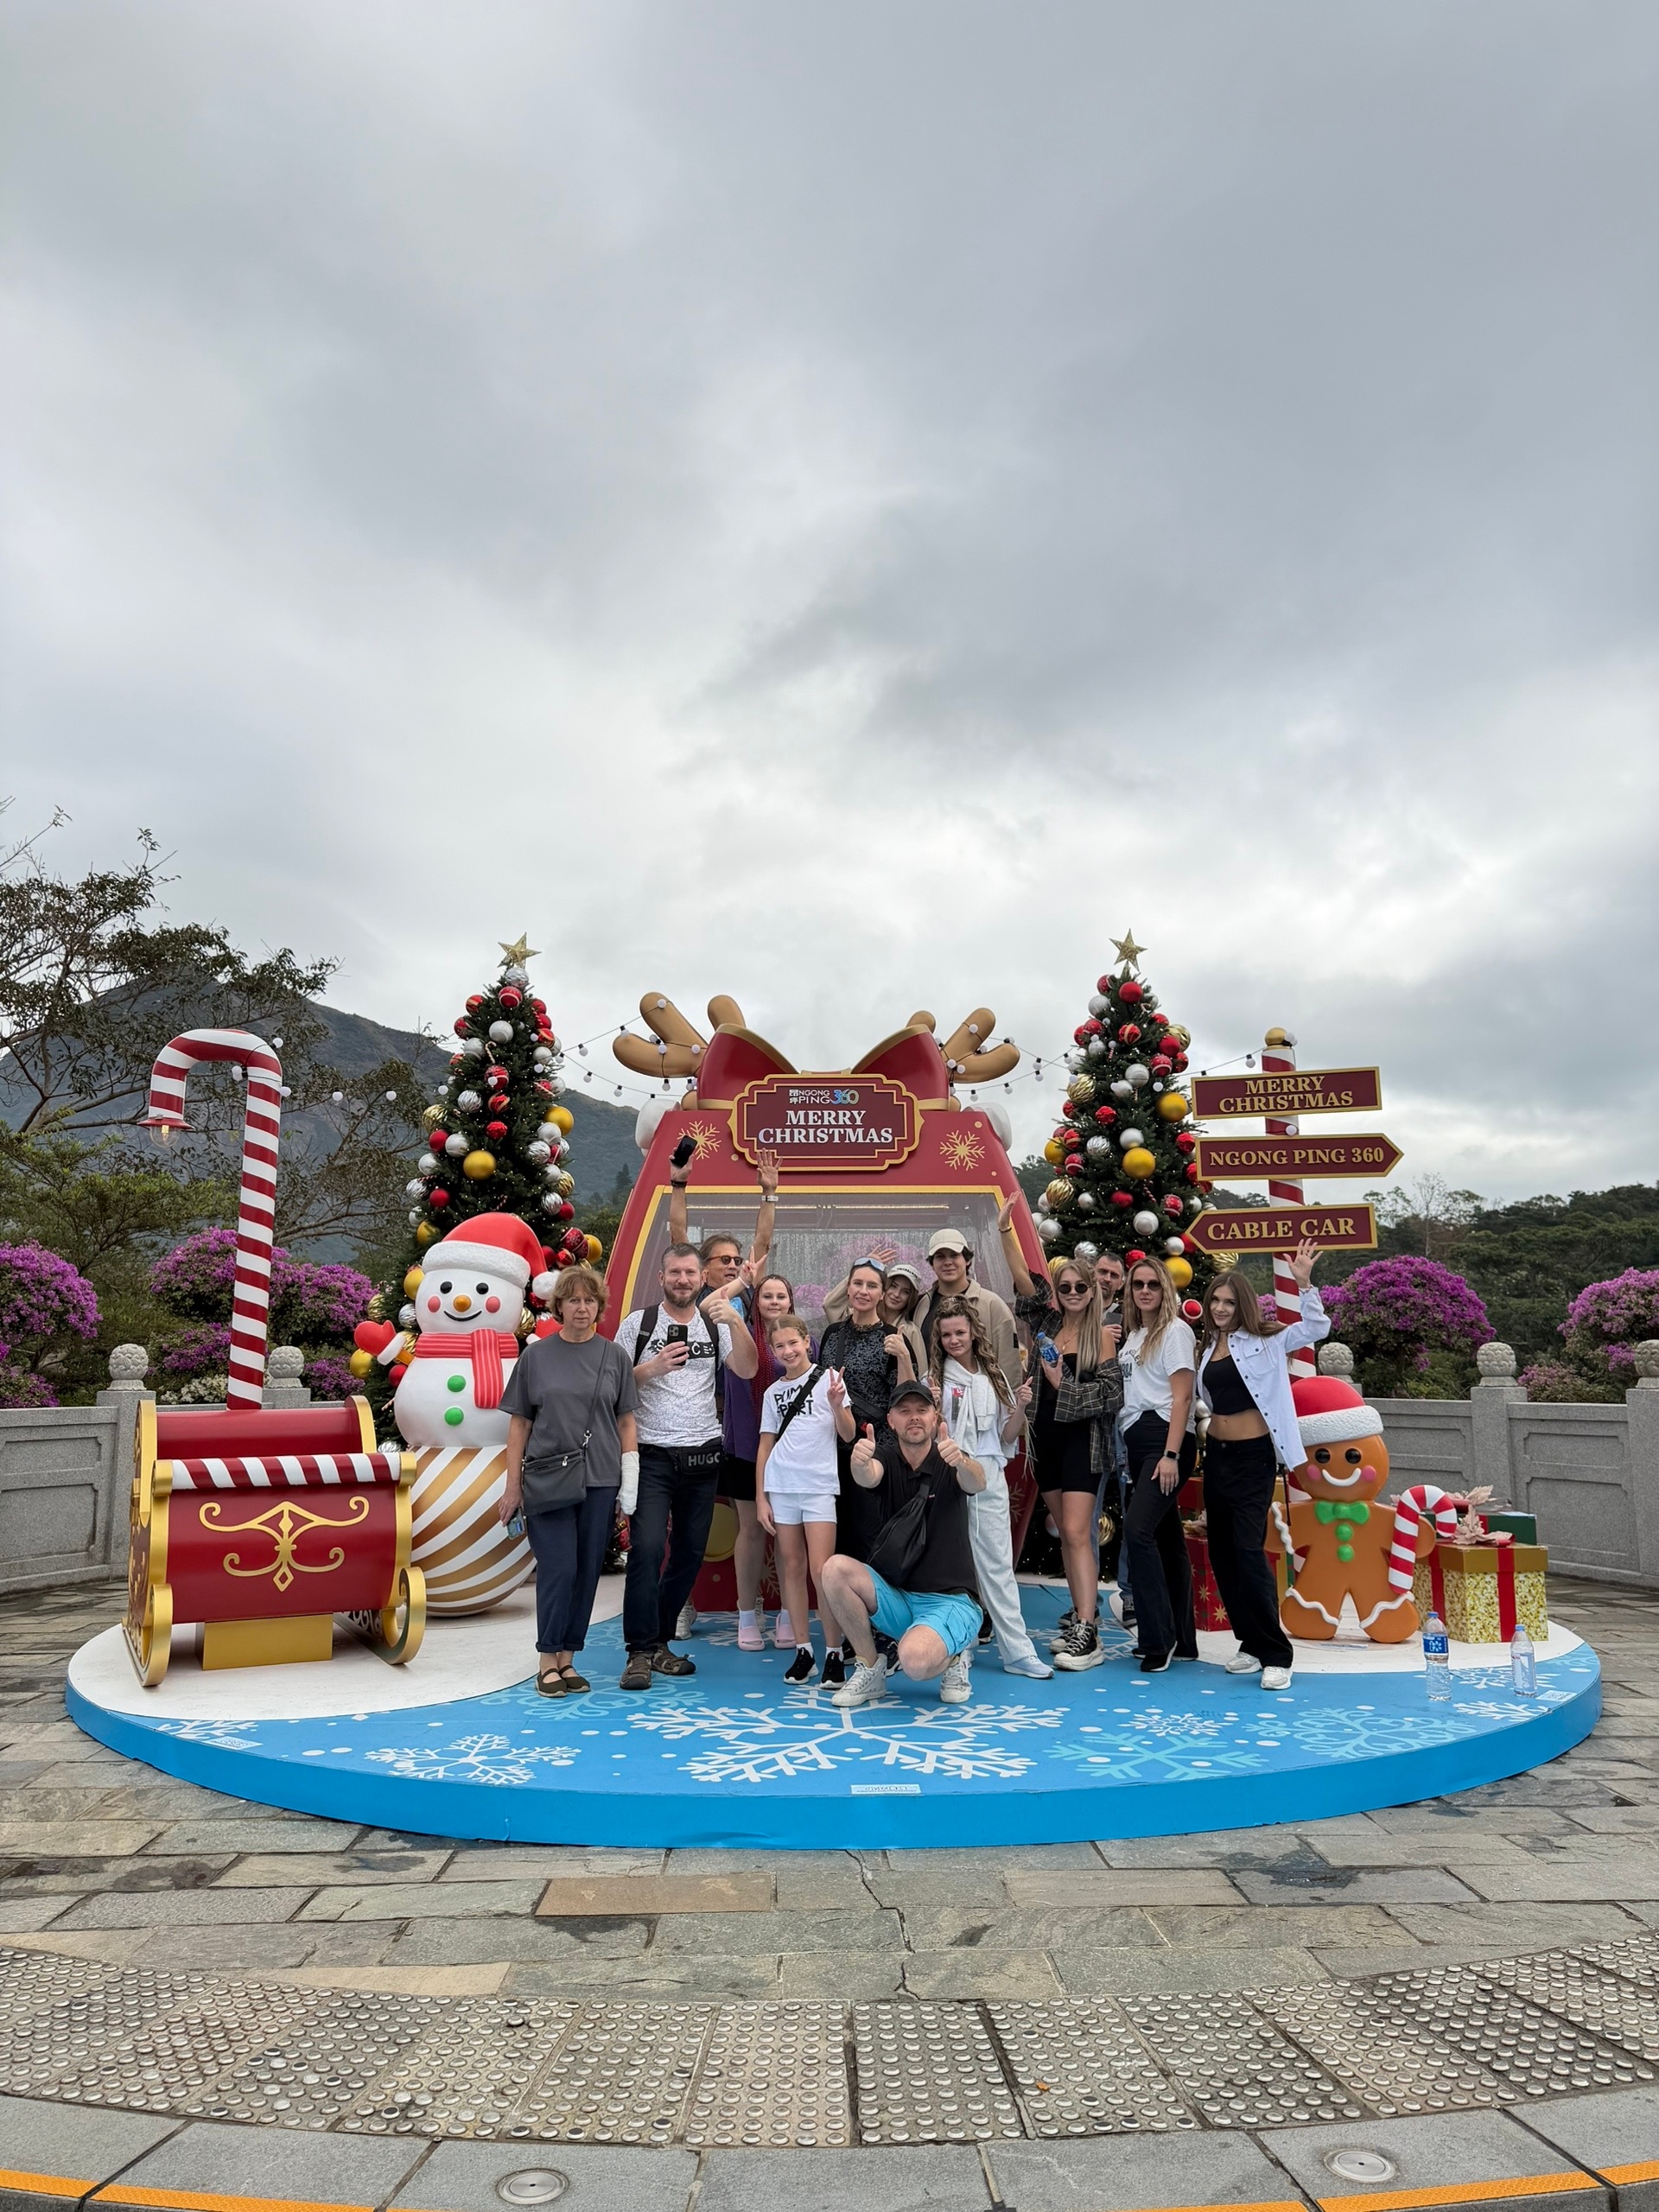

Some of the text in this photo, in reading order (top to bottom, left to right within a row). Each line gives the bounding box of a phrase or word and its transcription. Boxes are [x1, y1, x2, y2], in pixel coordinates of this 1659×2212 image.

[1245, 1076, 1325, 1095] MERRY
[830, 1089, 860, 1104] 360
[1219, 1090, 1353, 1113] CHRISTMAS
[785, 1110, 866, 1126] MERRY
[758, 1128, 893, 1144] CHRISTMAS
[1210, 1147, 1384, 1166] NGONG PING 360
[1207, 1217, 1357, 1240] CABLE CAR
